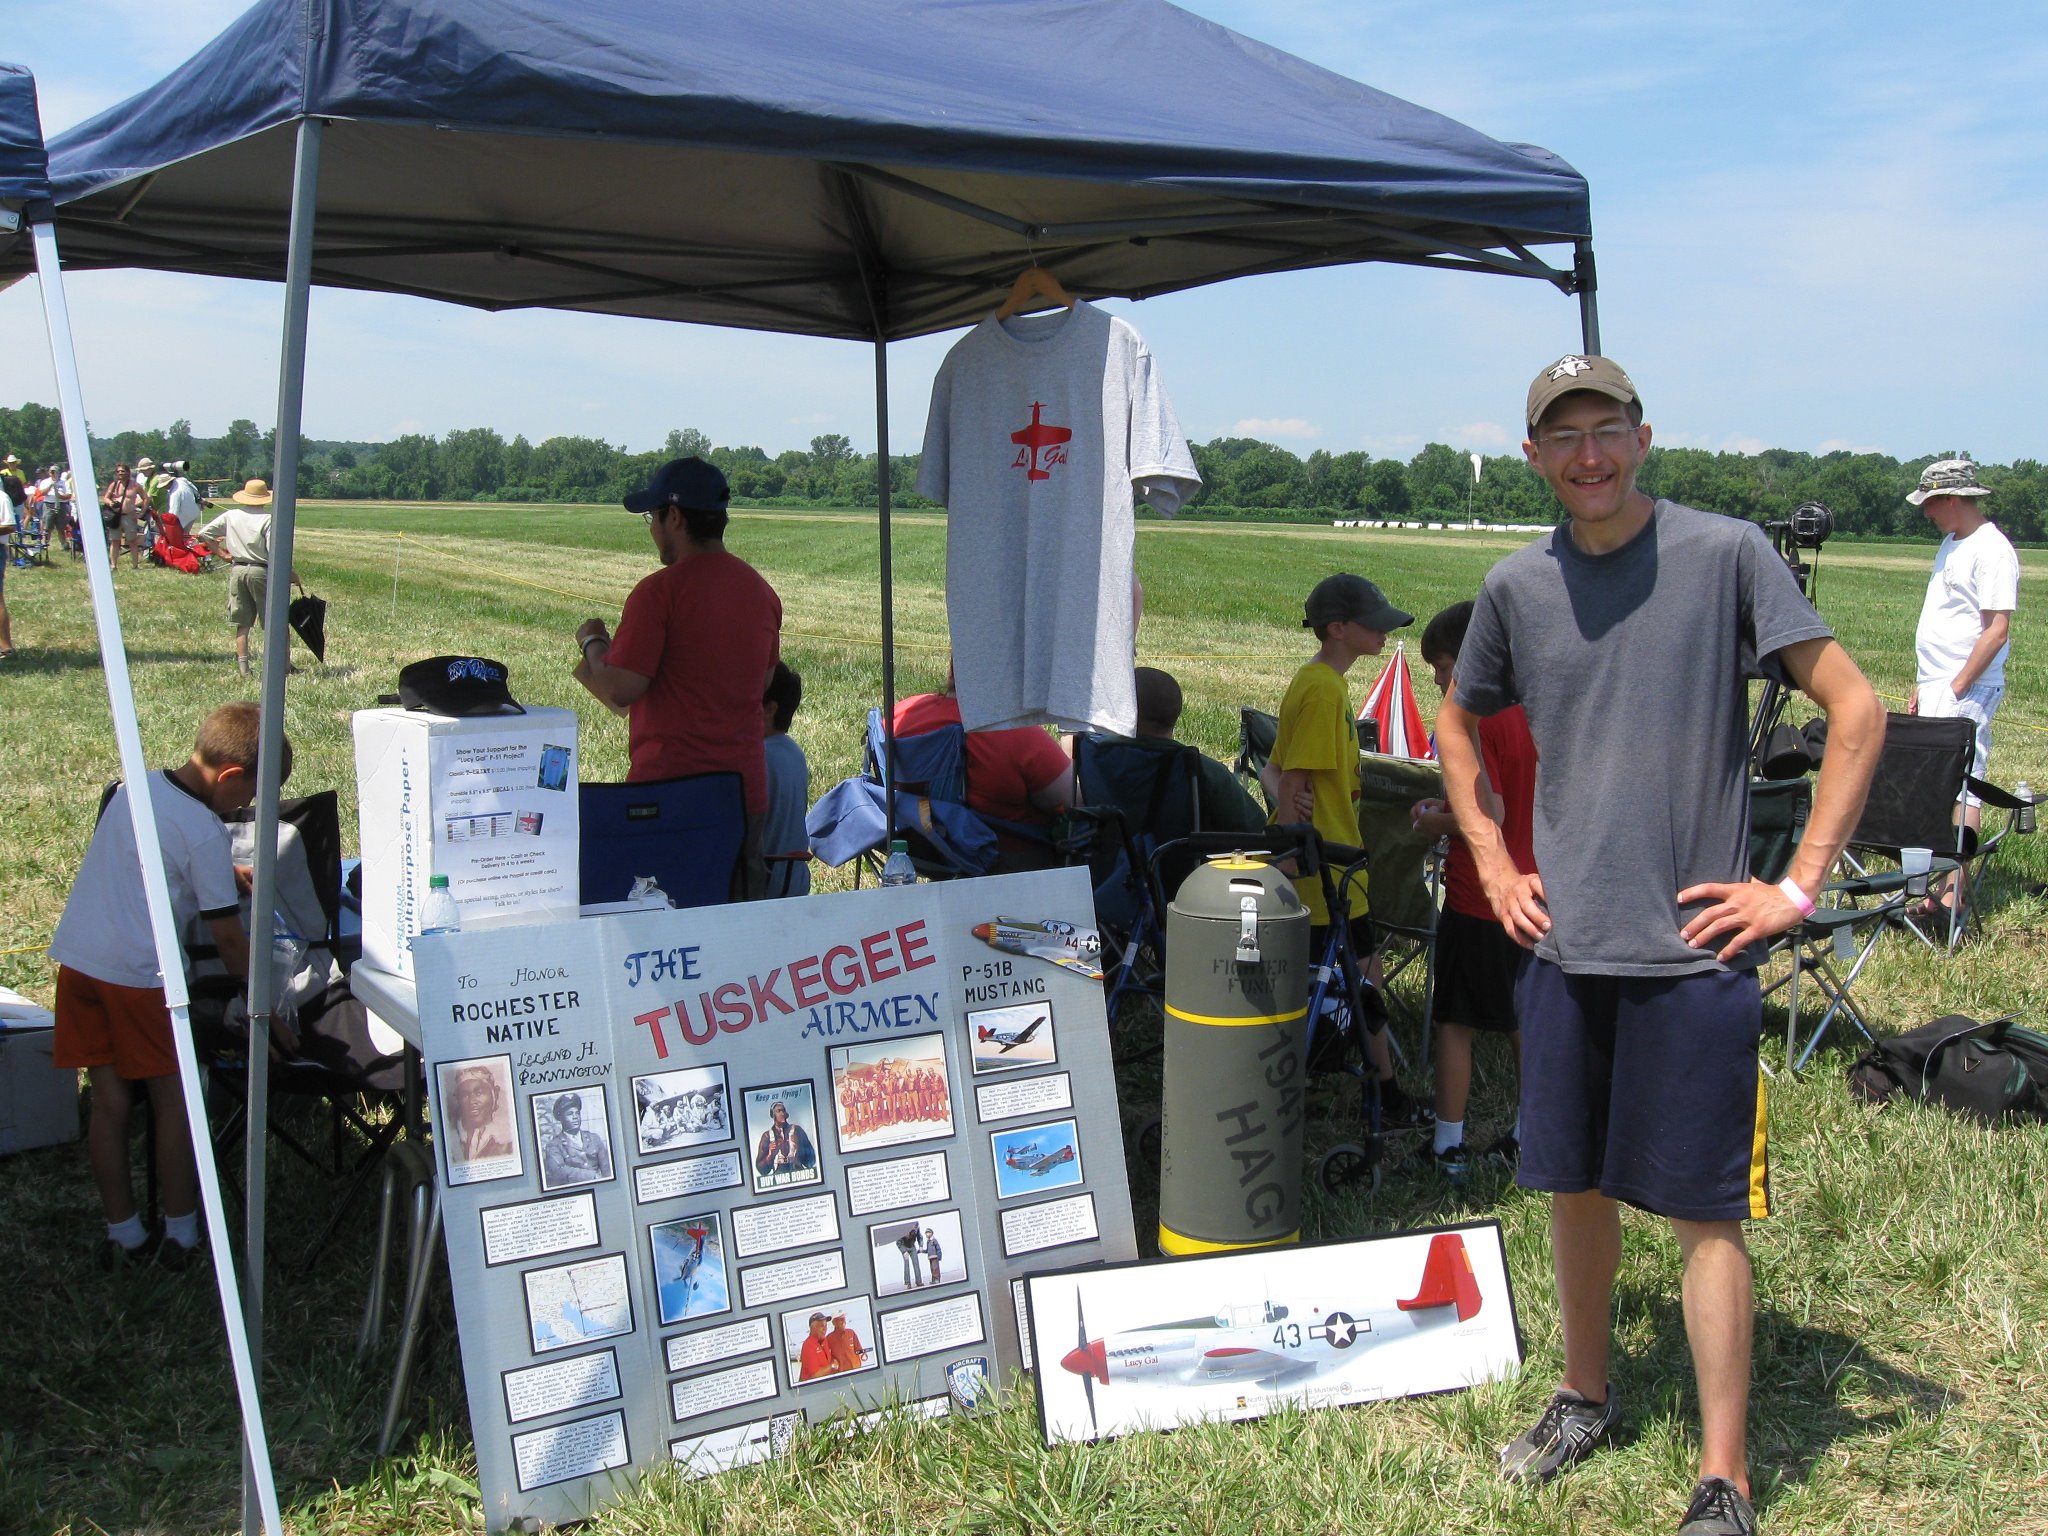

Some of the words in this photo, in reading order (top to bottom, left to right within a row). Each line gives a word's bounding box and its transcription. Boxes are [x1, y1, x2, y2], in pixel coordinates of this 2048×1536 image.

[1044, 445, 1068, 470] Gal
[487, 746, 508, 754] Support
[402, 759, 412, 813] Paper
[405, 821, 415, 952] Multipurpose
[1064, 936, 1078, 951] A4
[624, 946, 701, 988] THE
[962, 961, 1012, 982] P-51B
[633, 918, 936, 1059] TUSKEGEE
[965, 978, 1046, 1004] MUSTANG
[1228, 978, 1277, 994] FUND
[452, 990, 580, 1022] ROCHESTER
[802, 991, 940, 1039] AIRMEN
[486, 1018, 560, 1044] NATIVE
[516, 1048, 572, 1067] LELAND
[518, 1063, 612, 1086] PENNINGTON
[1216, 1100, 1285, 1228] HAG
[760, 1175, 775, 1188] BUY
[775, 1172, 791, 1184] WAR
[791, 1168, 815, 1182] BONDS
[1272, 1323, 1302, 1350] 43
[952, 1358, 982, 1370] AIRCRAFT
[1124, 1358, 1142, 1368] Lucy
[1144, 1355, 1159, 1365] Gal
[948, 1374, 968, 1406] HISTORICAL
